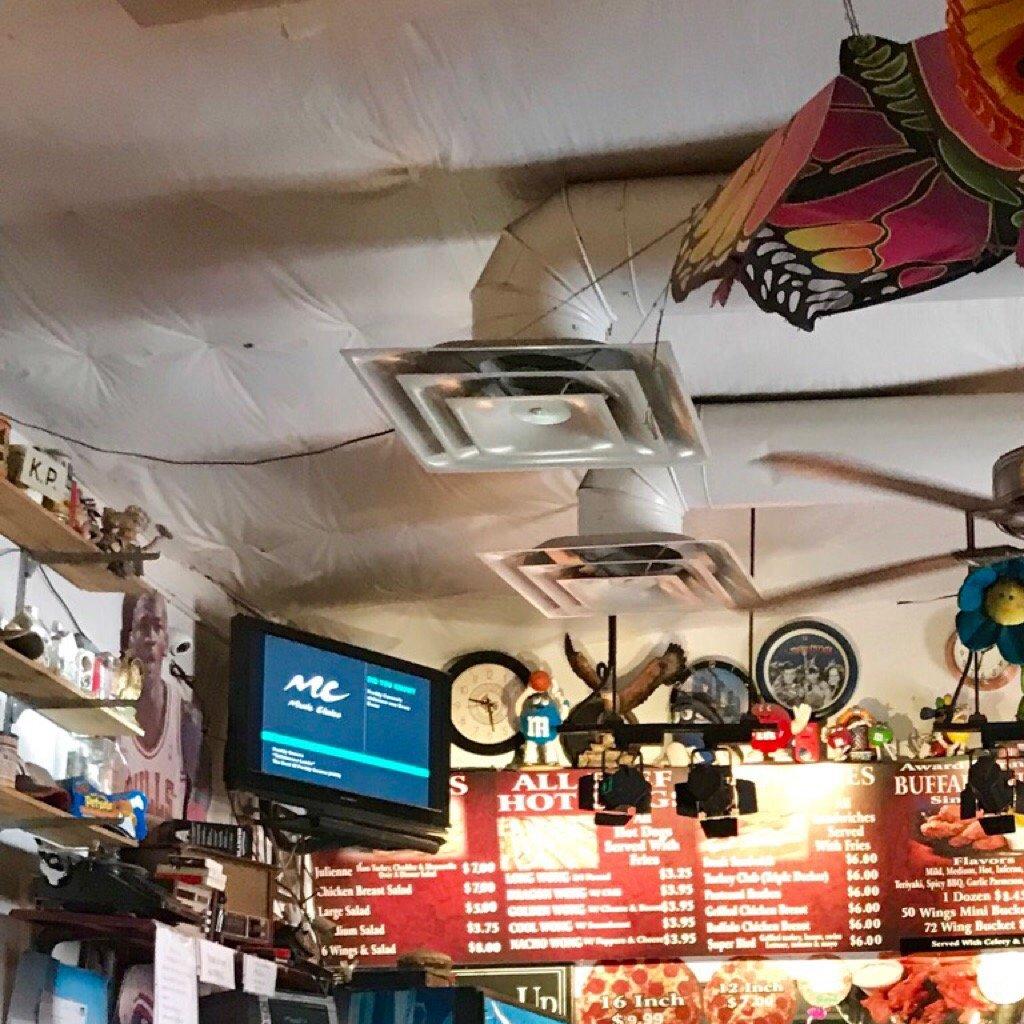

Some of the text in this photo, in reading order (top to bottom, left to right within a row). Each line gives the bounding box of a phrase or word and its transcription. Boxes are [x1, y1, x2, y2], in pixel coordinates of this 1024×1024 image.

[511, 773, 578, 791] ALL
[497, 793, 576, 811] HOT
[953, 857, 1015, 865] Flavors
[943, 892, 991, 902] 1 Dozen
[901, 908, 916, 918] 50
[920, 907, 956, 920] Wings
[960, 905, 988, 916] Mini
[924, 920, 1015, 935] 72 Wing Bucket
[602, 992, 684, 1009] 16 Inch
